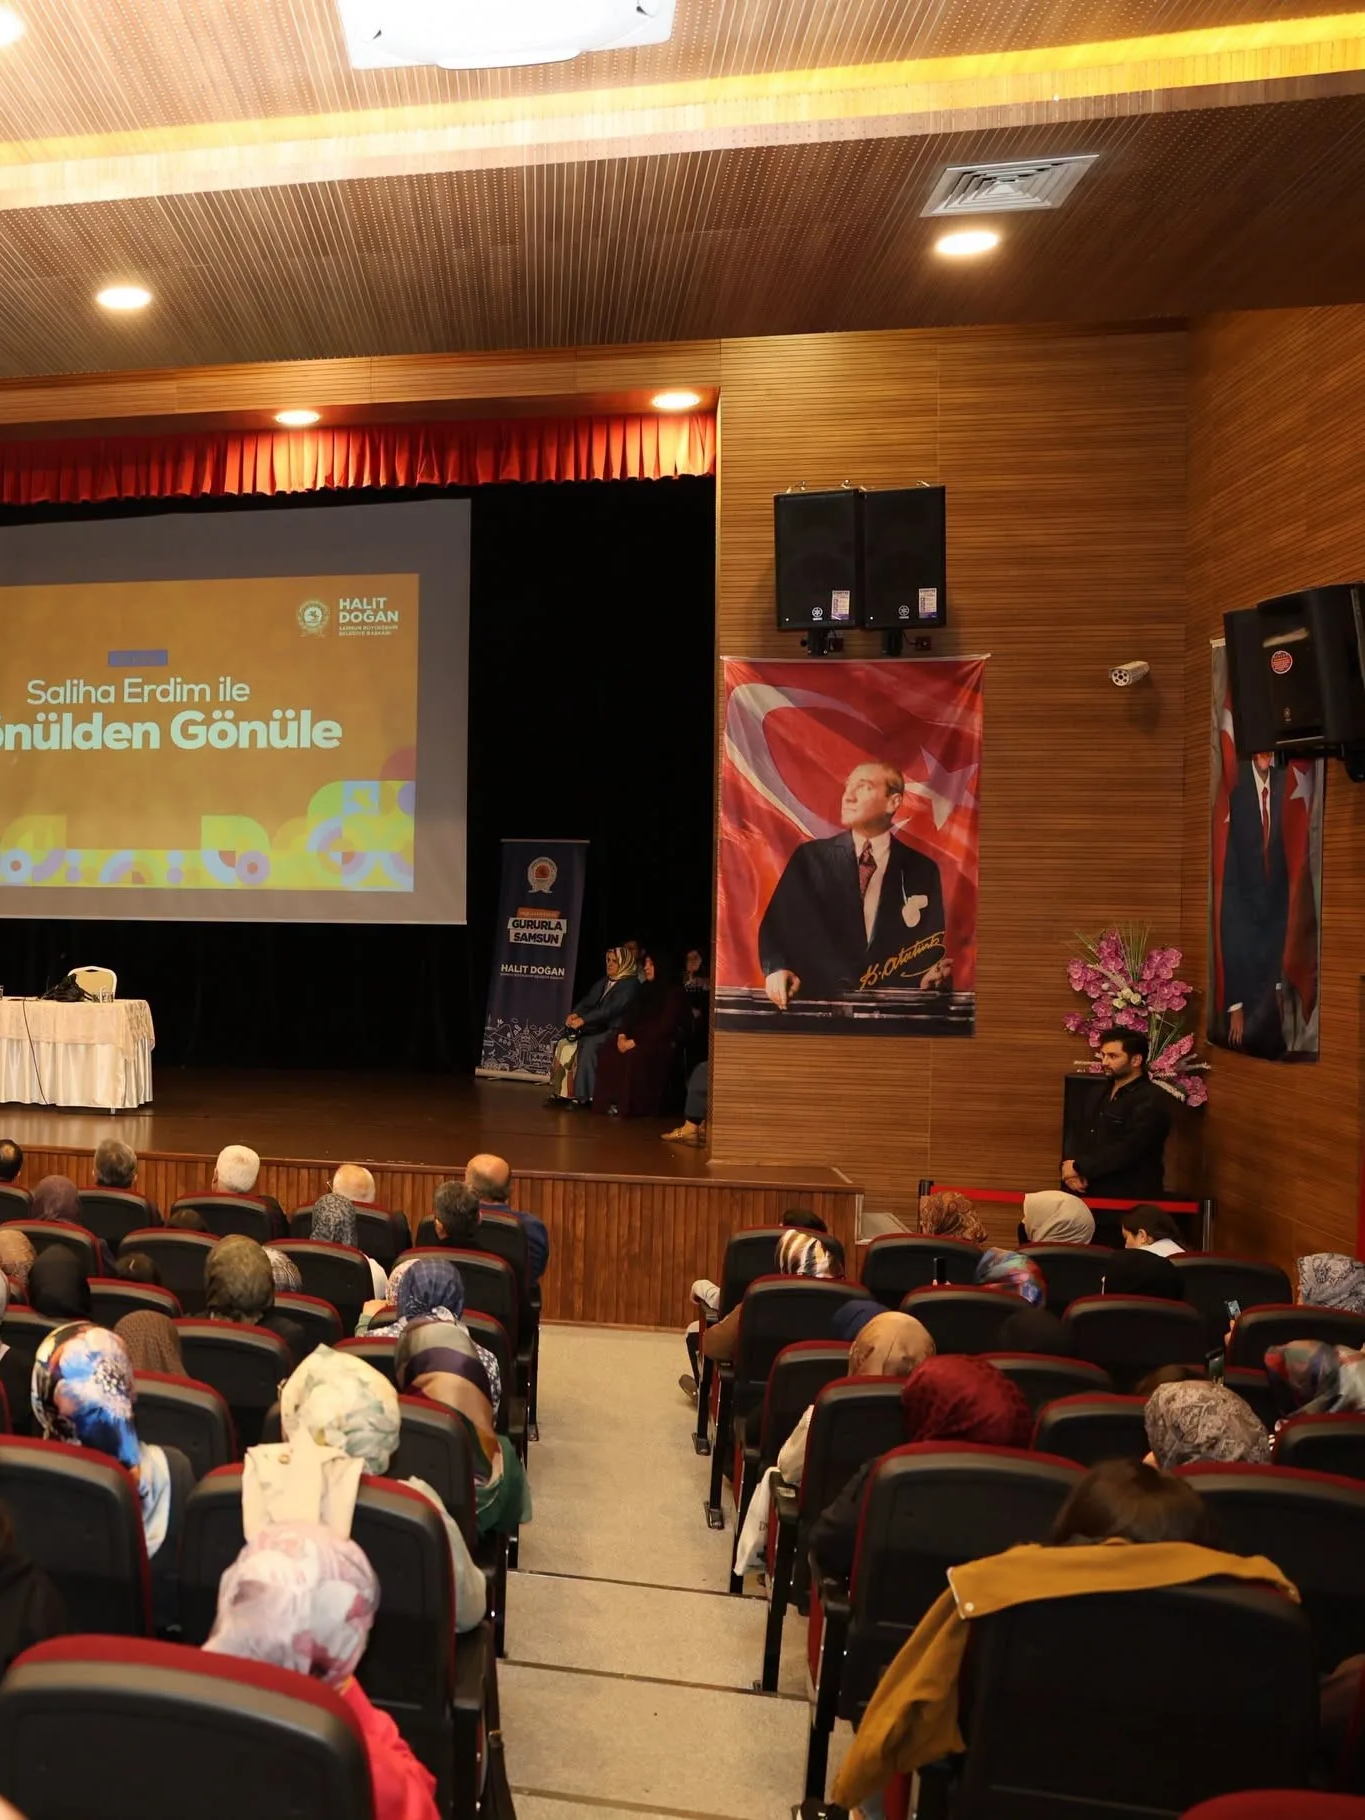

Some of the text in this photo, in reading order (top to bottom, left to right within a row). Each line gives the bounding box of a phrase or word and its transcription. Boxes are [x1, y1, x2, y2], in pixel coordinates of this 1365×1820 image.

[339, 610, 398, 623] DOĞAN
[27, 676, 250, 706] Saliha Erdim ile
[170, 708, 343, 750] Gönüle
[512, 920, 562, 931] GURURLA
[513, 932, 559, 944] SAMSUN
